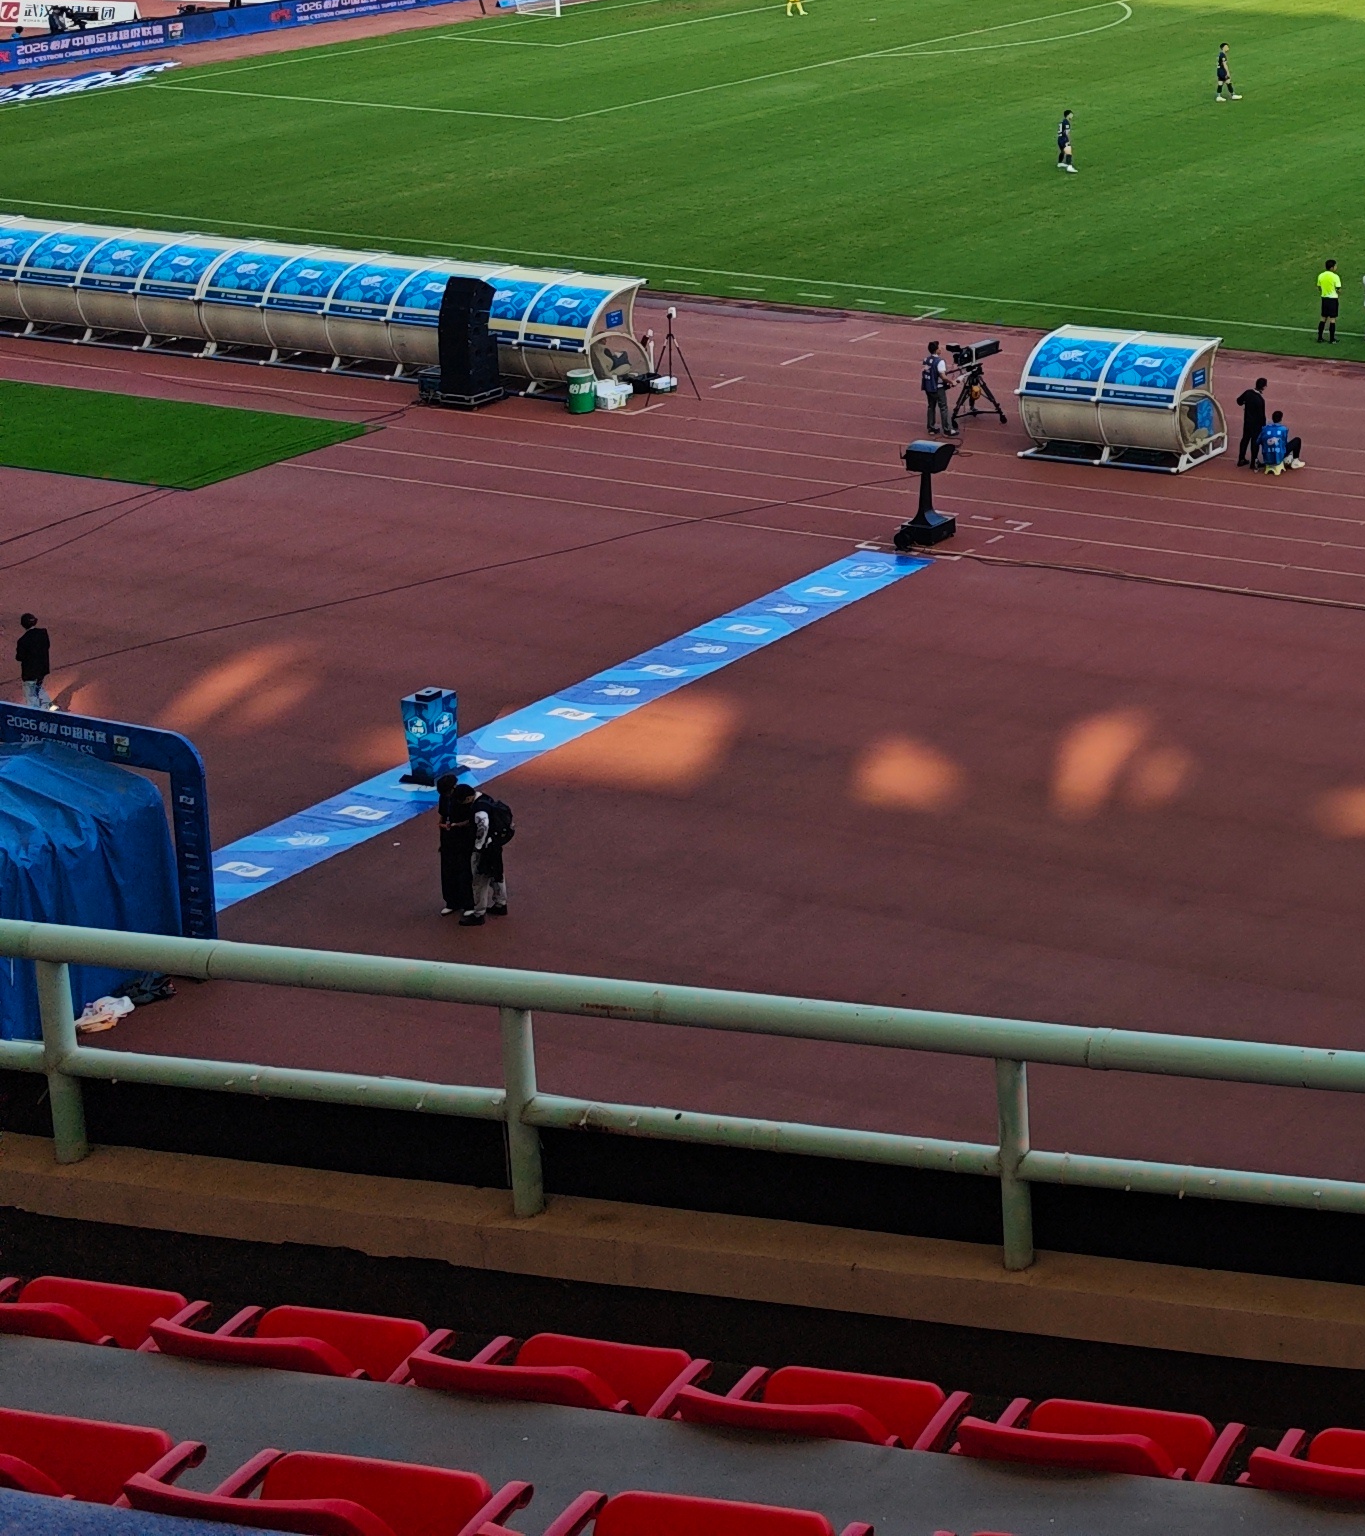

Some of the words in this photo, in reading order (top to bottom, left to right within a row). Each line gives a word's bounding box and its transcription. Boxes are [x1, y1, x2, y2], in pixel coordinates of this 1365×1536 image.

[296, 1, 322, 13] 2026
[16, 41, 49, 56] 2026
[72, 24, 164, 47] 中国足球超级联赛
[141, 37, 165, 48] LEAGUE
[7, 715, 37, 731] 2026
[60, 723, 107, 744] 中超联赛
